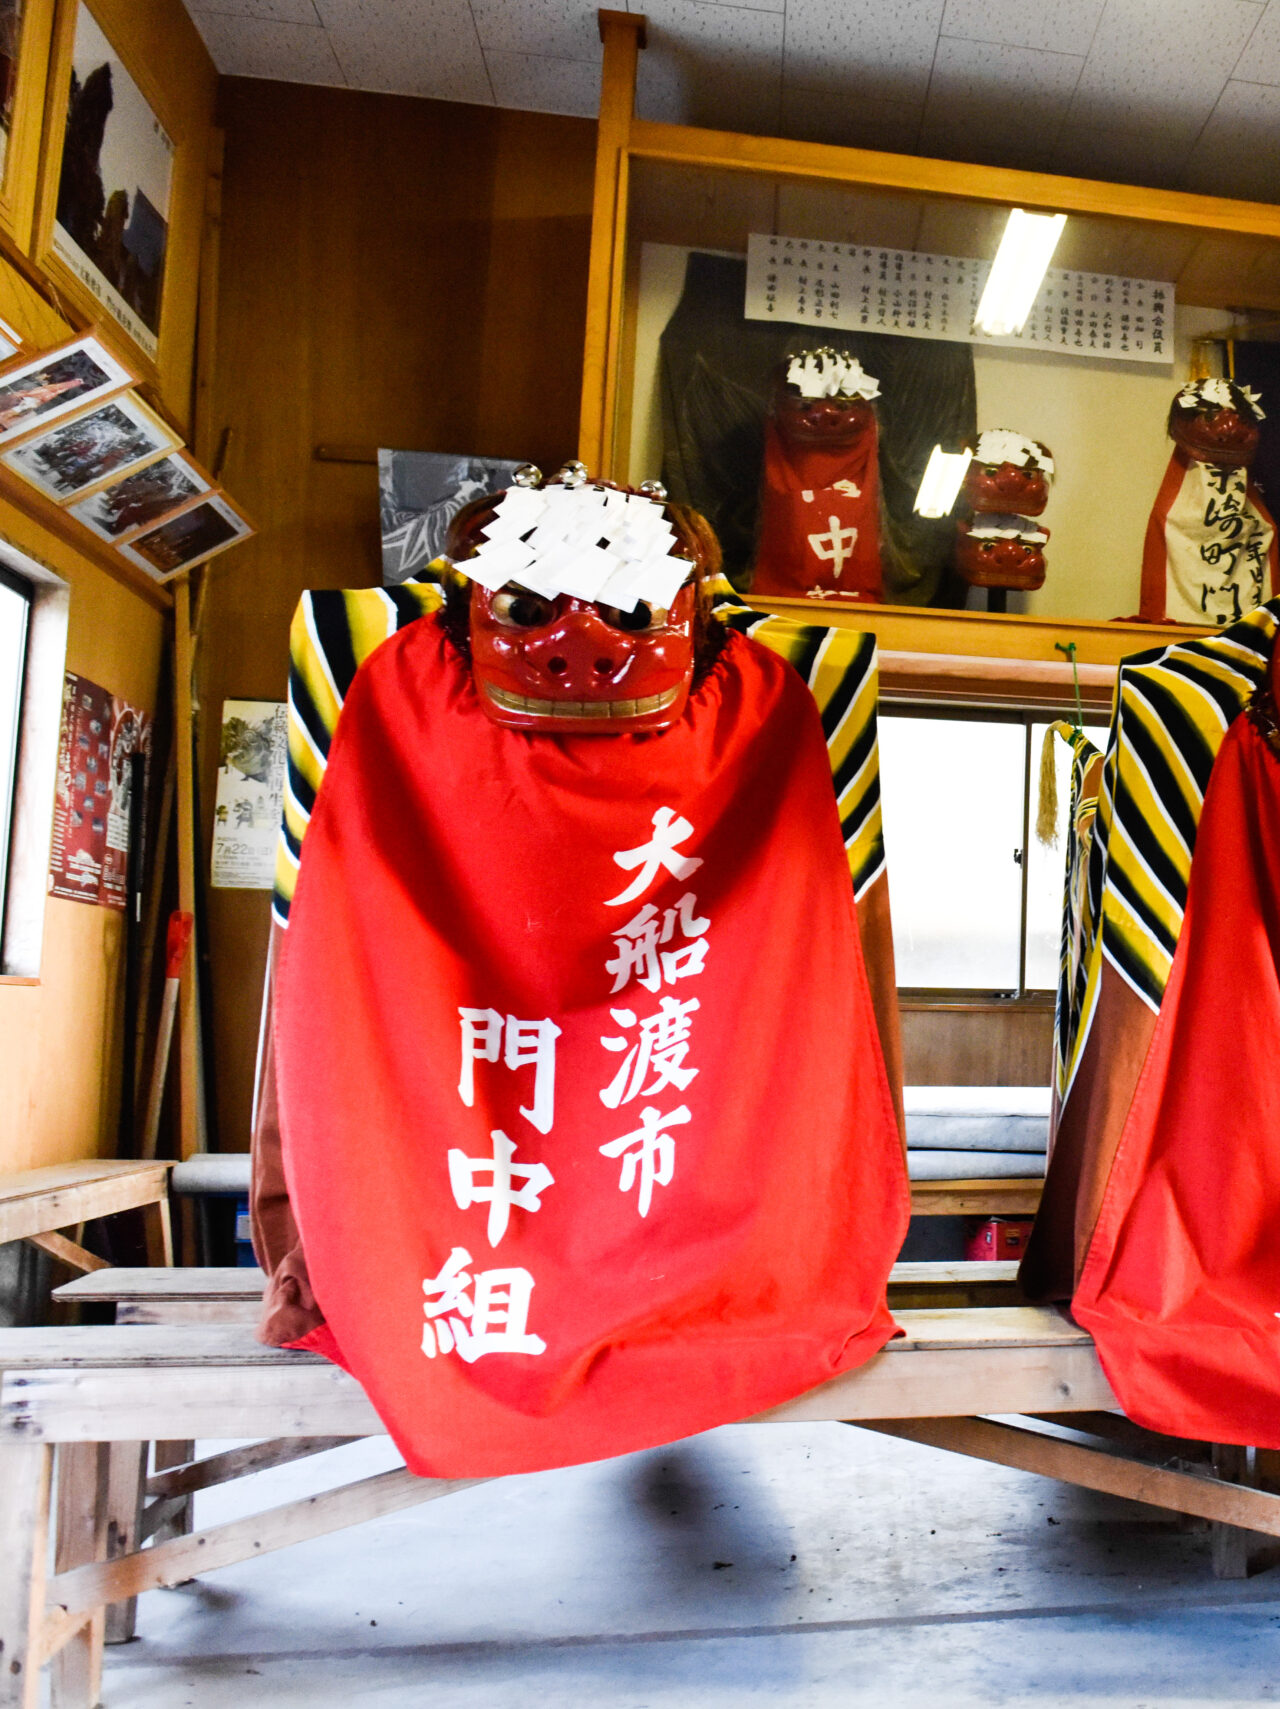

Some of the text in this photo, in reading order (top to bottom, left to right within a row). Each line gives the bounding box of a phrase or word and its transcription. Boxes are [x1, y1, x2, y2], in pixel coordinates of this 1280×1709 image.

[420, 1006, 562, 1363] 門中組
[599, 806, 711, 1218] 大船渡市
